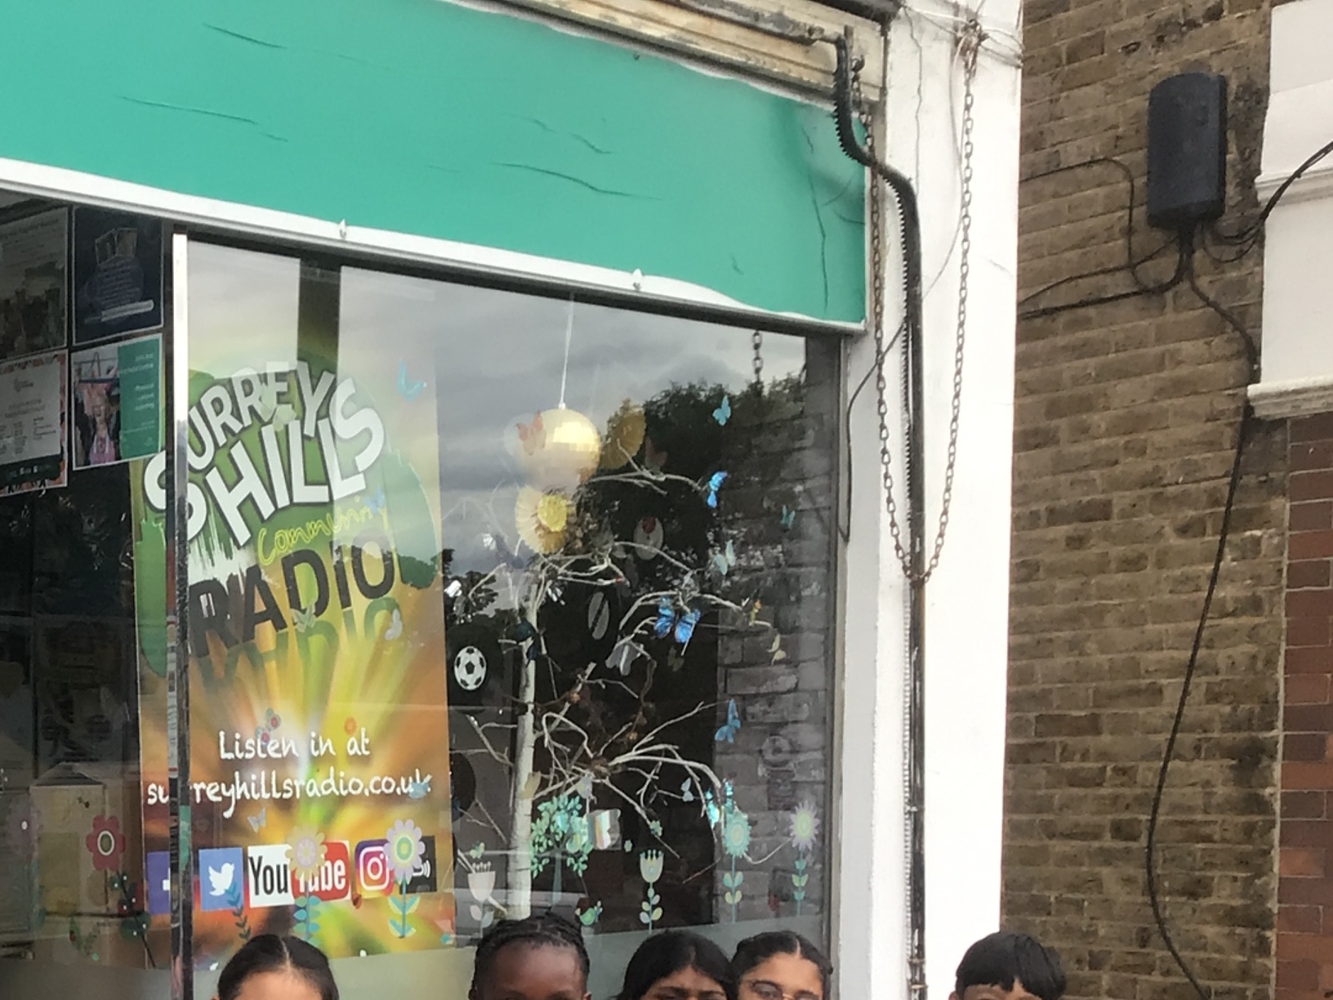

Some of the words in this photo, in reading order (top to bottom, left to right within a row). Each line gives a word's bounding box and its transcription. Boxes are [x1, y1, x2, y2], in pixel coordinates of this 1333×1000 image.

[205, 378, 385, 547] HILLS
[188, 528, 395, 657] RADIO
[219, 731, 298, 759] Listen
[310, 730, 335, 758] in
[347, 727, 370, 756] at
